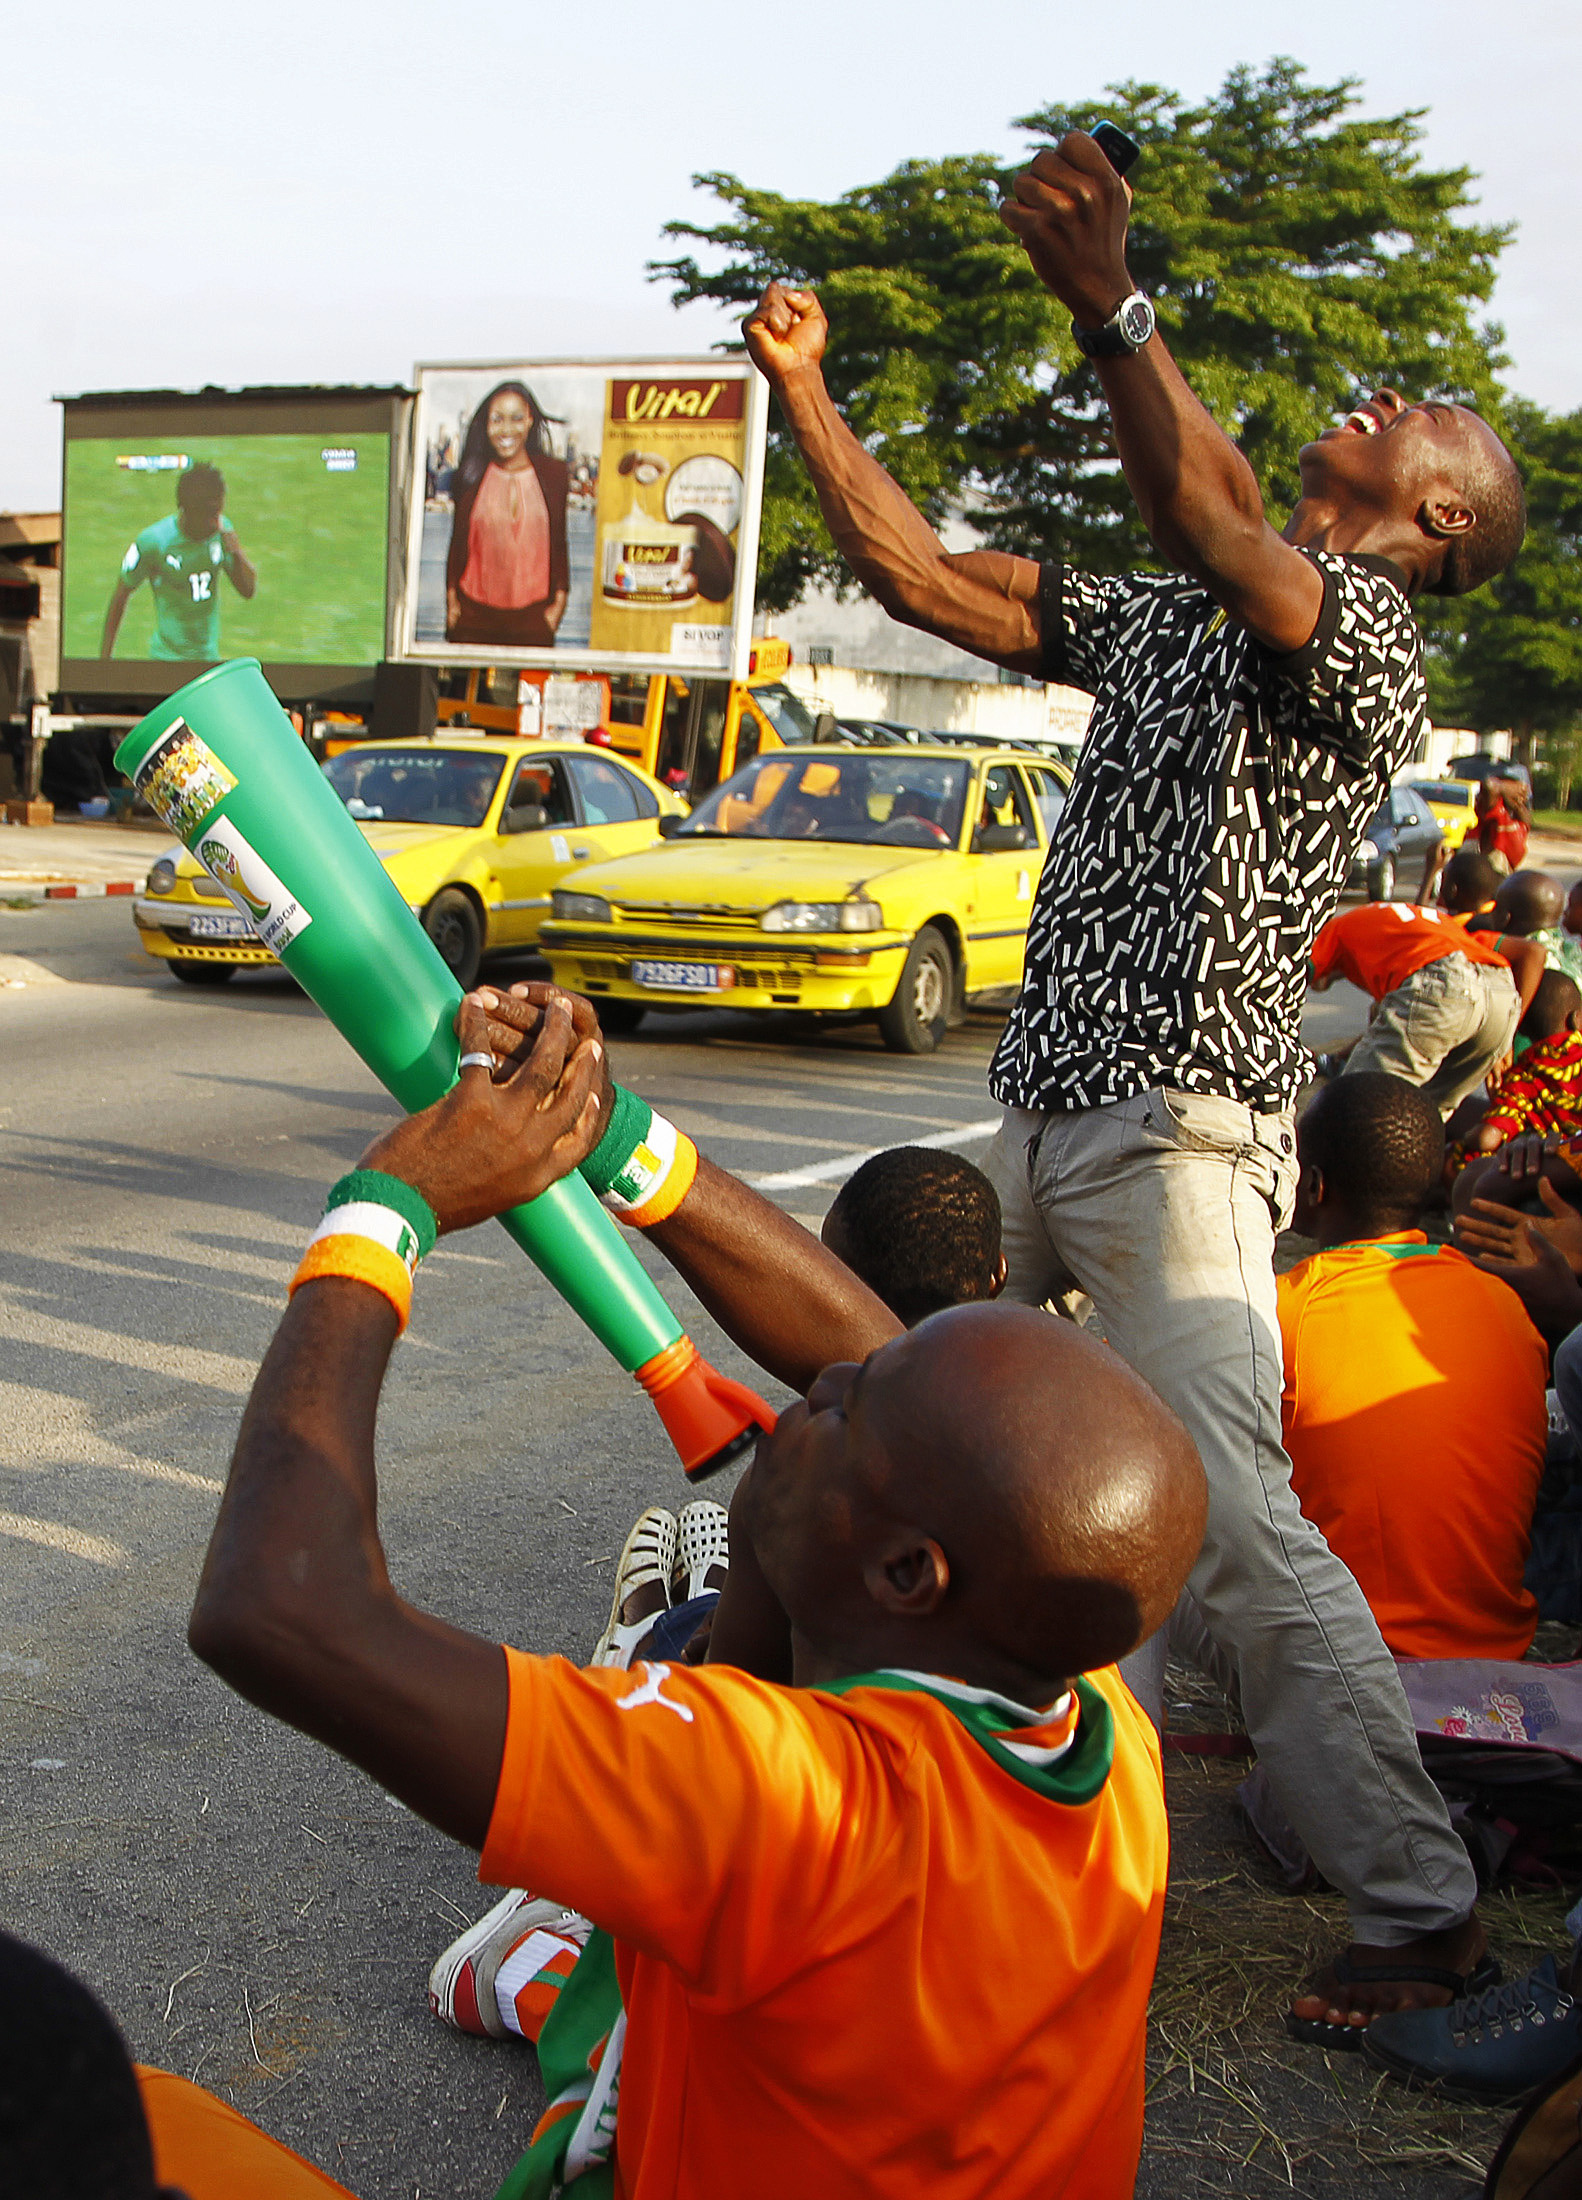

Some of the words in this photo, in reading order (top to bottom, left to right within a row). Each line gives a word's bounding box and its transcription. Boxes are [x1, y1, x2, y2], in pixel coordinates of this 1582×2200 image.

[626, 382, 721, 422] Vital
[188, 571, 211, 602] 12
[282, 902, 297, 920] CUP
